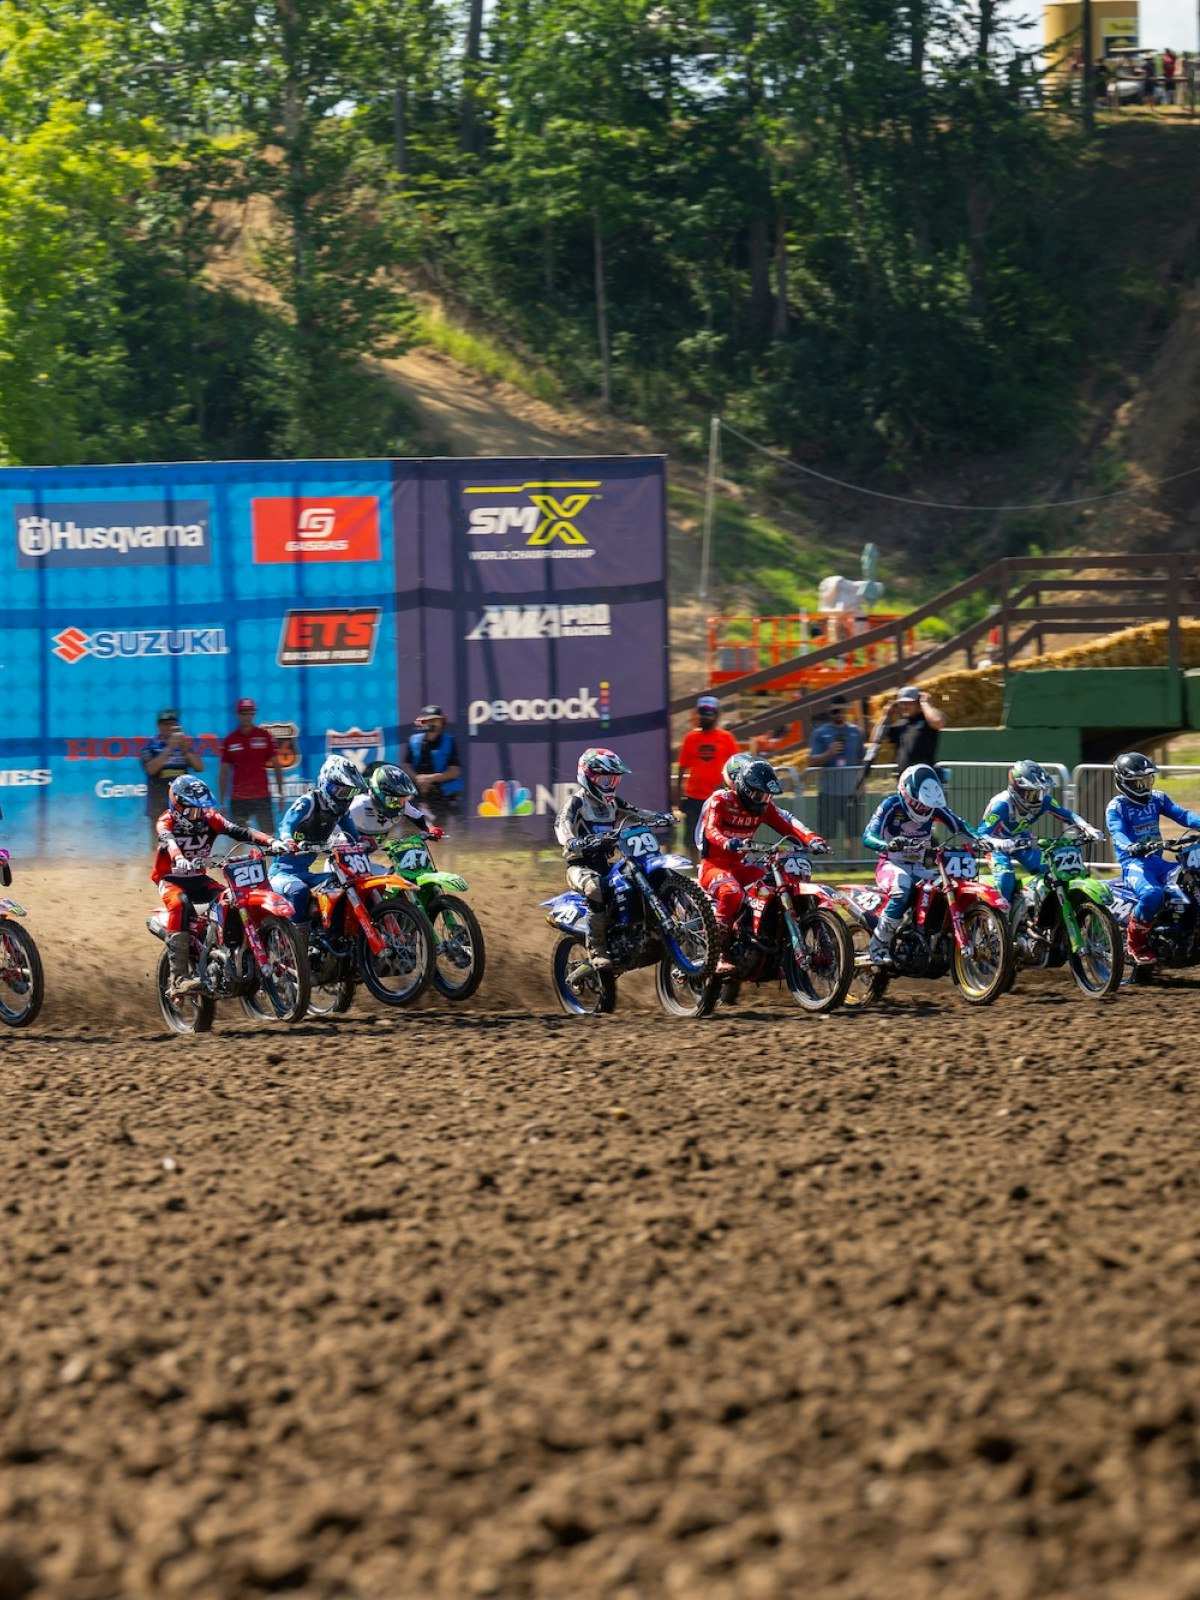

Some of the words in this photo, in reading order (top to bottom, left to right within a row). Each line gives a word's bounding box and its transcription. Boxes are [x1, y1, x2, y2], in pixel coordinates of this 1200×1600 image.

[467, 494, 592, 545] SMX
[51, 521, 204, 553] Husqvarna
[285, 540, 349, 551] GASGAS
[287, 614, 377, 648] ETS
[465, 604, 561, 640] AMA
[562, 604, 610, 625] PRO
[90, 630, 225, 658] SUZUKI
[469, 688, 599, 736] peacock
[65, 734, 222, 761] HONA
[535, 783, 582, 815] NB
[627, 832, 660, 857] 29
[347, 852, 371, 875] 361
[401, 849, 429, 871] 47
[946, 856, 978, 879] 43
[234, 864, 266, 888] 20
[555, 904, 579, 924] 29
